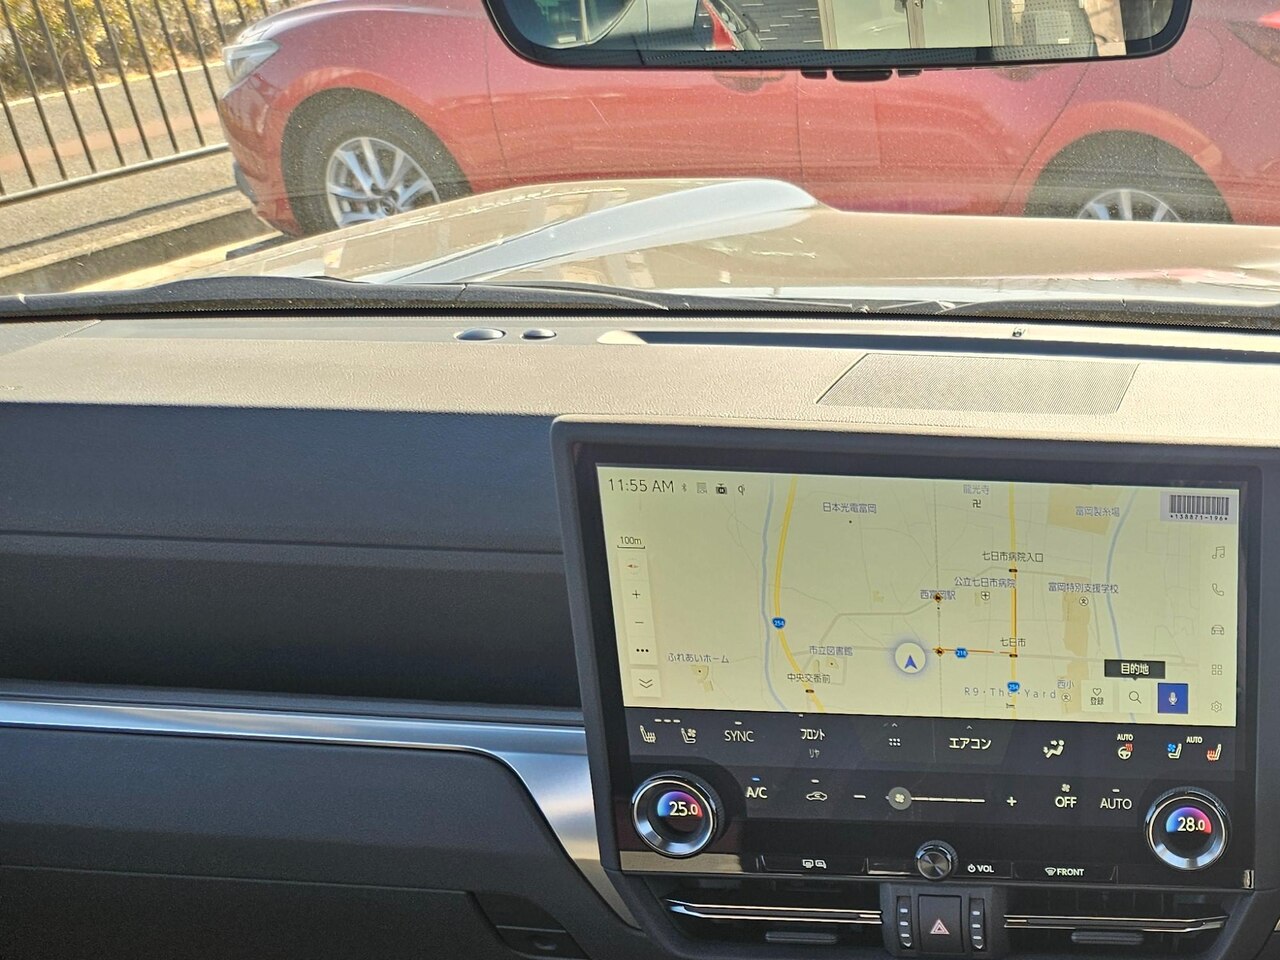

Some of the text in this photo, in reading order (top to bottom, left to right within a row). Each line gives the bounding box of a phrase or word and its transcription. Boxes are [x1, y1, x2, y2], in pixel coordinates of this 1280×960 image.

[609, 478, 675, 493] 11:55 AM
[620, 536, 642, 545] 100m
[982, 551, 1044, 562] 七日市病院入口
[954, 576, 1016, 588] 公立七日市病院
[1001, 638, 1026, 647] 七日市
[809, 645, 853, 656] 市立図書館
[668, 653, 729, 664] ふれあいホーム
[1121, 663, 1150, 675] 目的地
[787, 673, 831, 684] 中央交番前
[724, 730, 755, 742] SYNC
[800, 728, 825, 741] フロント
[1117, 733, 1134, 742] AUTO
[1186, 736, 1203, 744] AUTO
[949, 737, 992, 750] エアコン
[808, 748, 820, 758] リヤ
[746, 786, 768, 799] A/C
[1055, 796, 1078, 808] OFF
[1100, 797, 1133, 810] AUTO
[669, 801, 699, 816] 25.0
[1177, 817, 1206, 832] 28.0
[977, 864, 995, 873] VOL
[1056, 867, 1085, 876] FRONT
